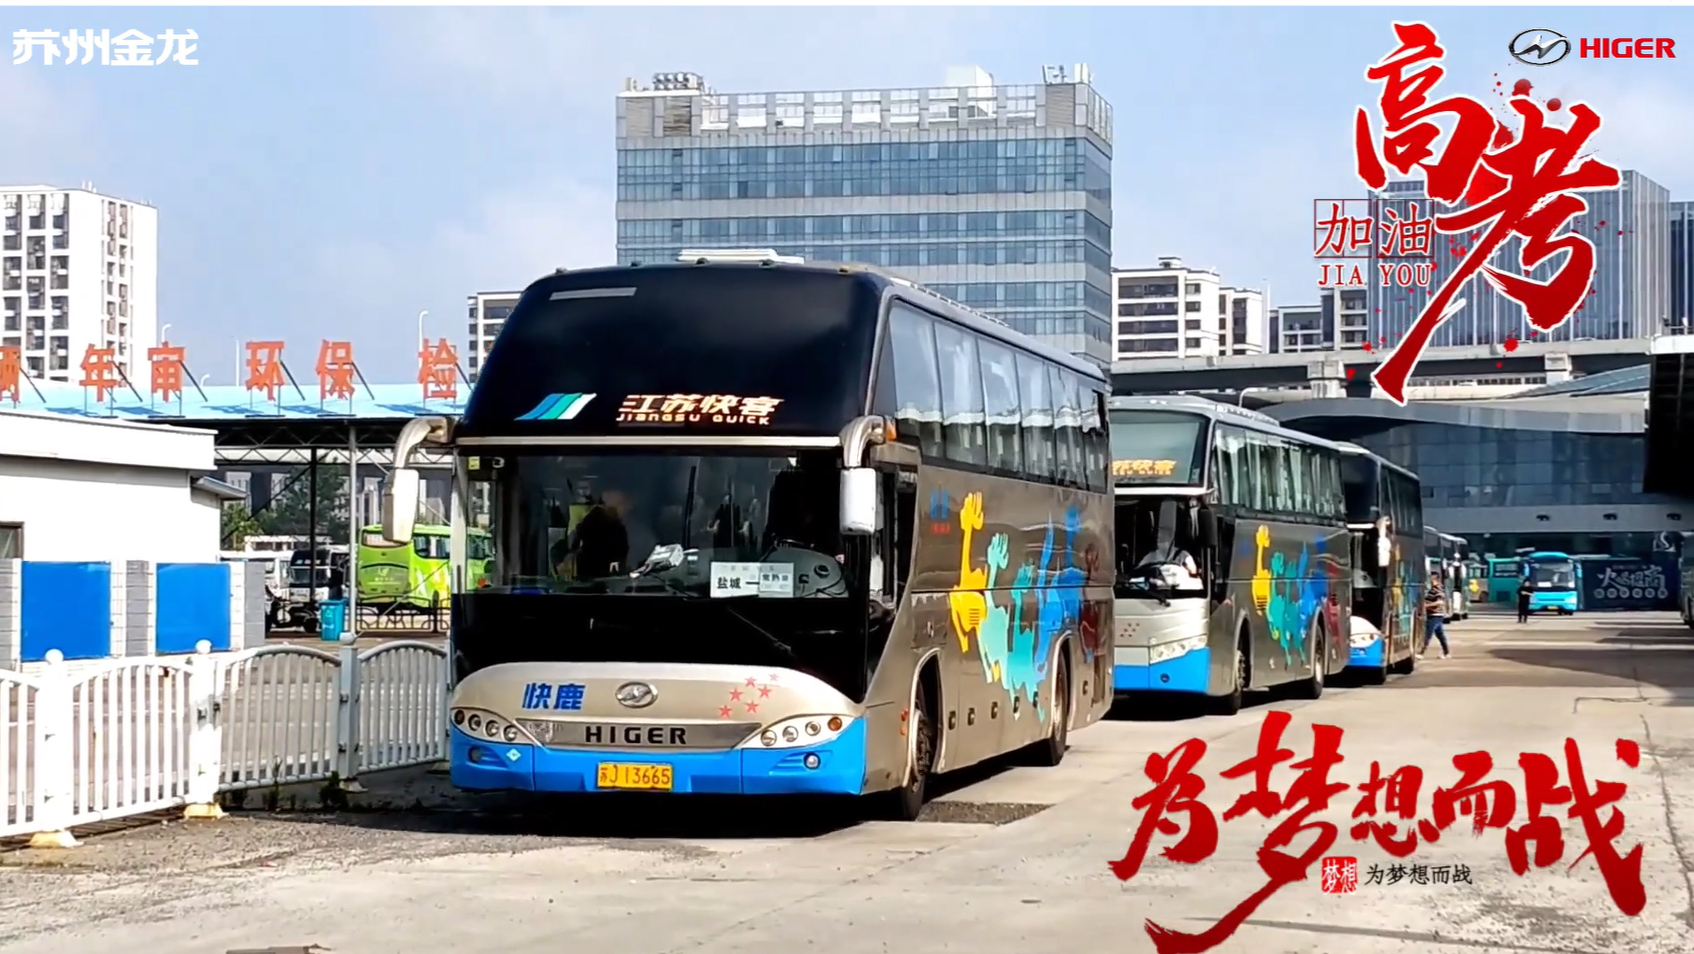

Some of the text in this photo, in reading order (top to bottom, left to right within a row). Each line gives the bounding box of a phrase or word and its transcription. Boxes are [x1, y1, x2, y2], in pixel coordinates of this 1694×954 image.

[618, 394, 785, 416] 江苏快客
[521, 682, 587, 711] 快鹿
[585, 725, 687, 745] HIGER
